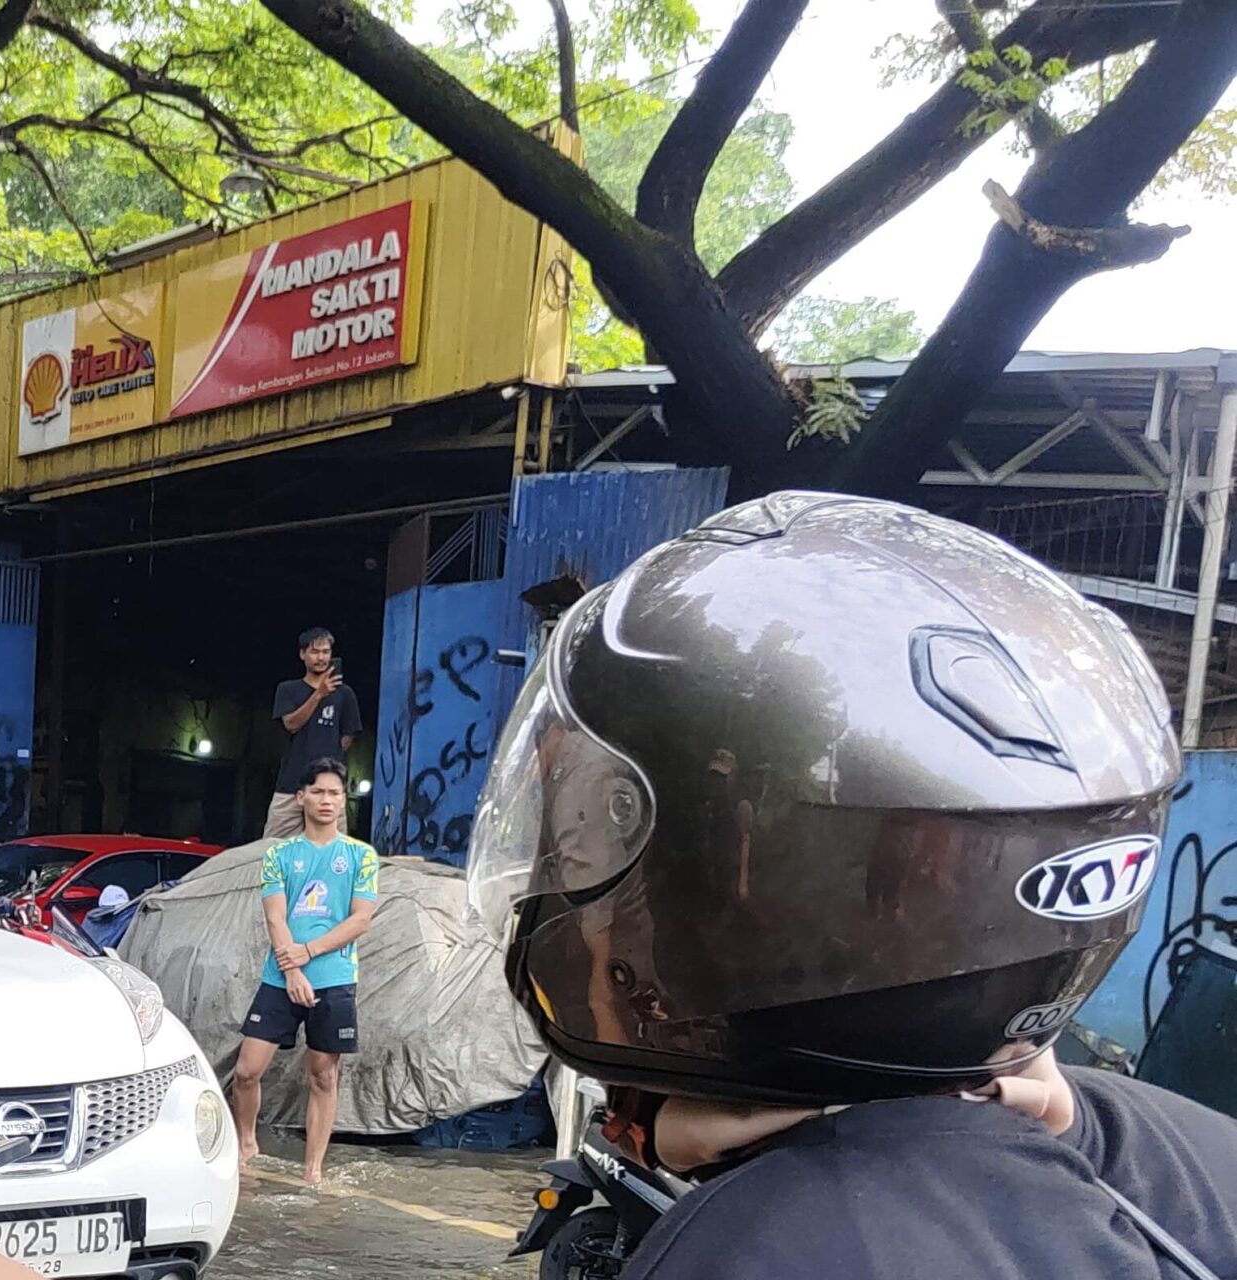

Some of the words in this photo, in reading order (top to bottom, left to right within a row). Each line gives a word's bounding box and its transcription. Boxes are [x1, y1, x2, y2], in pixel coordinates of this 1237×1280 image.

[262, 231, 401, 297] MANDALA
[310, 268, 400, 319] SAKTI
[291, 308, 396, 360] MOTOR
[71, 336, 151, 389] HELIX
[352, 356, 363, 368] 12
[1037, 848, 1150, 910] KYT
[1015, 1000, 1079, 1032] DOT
